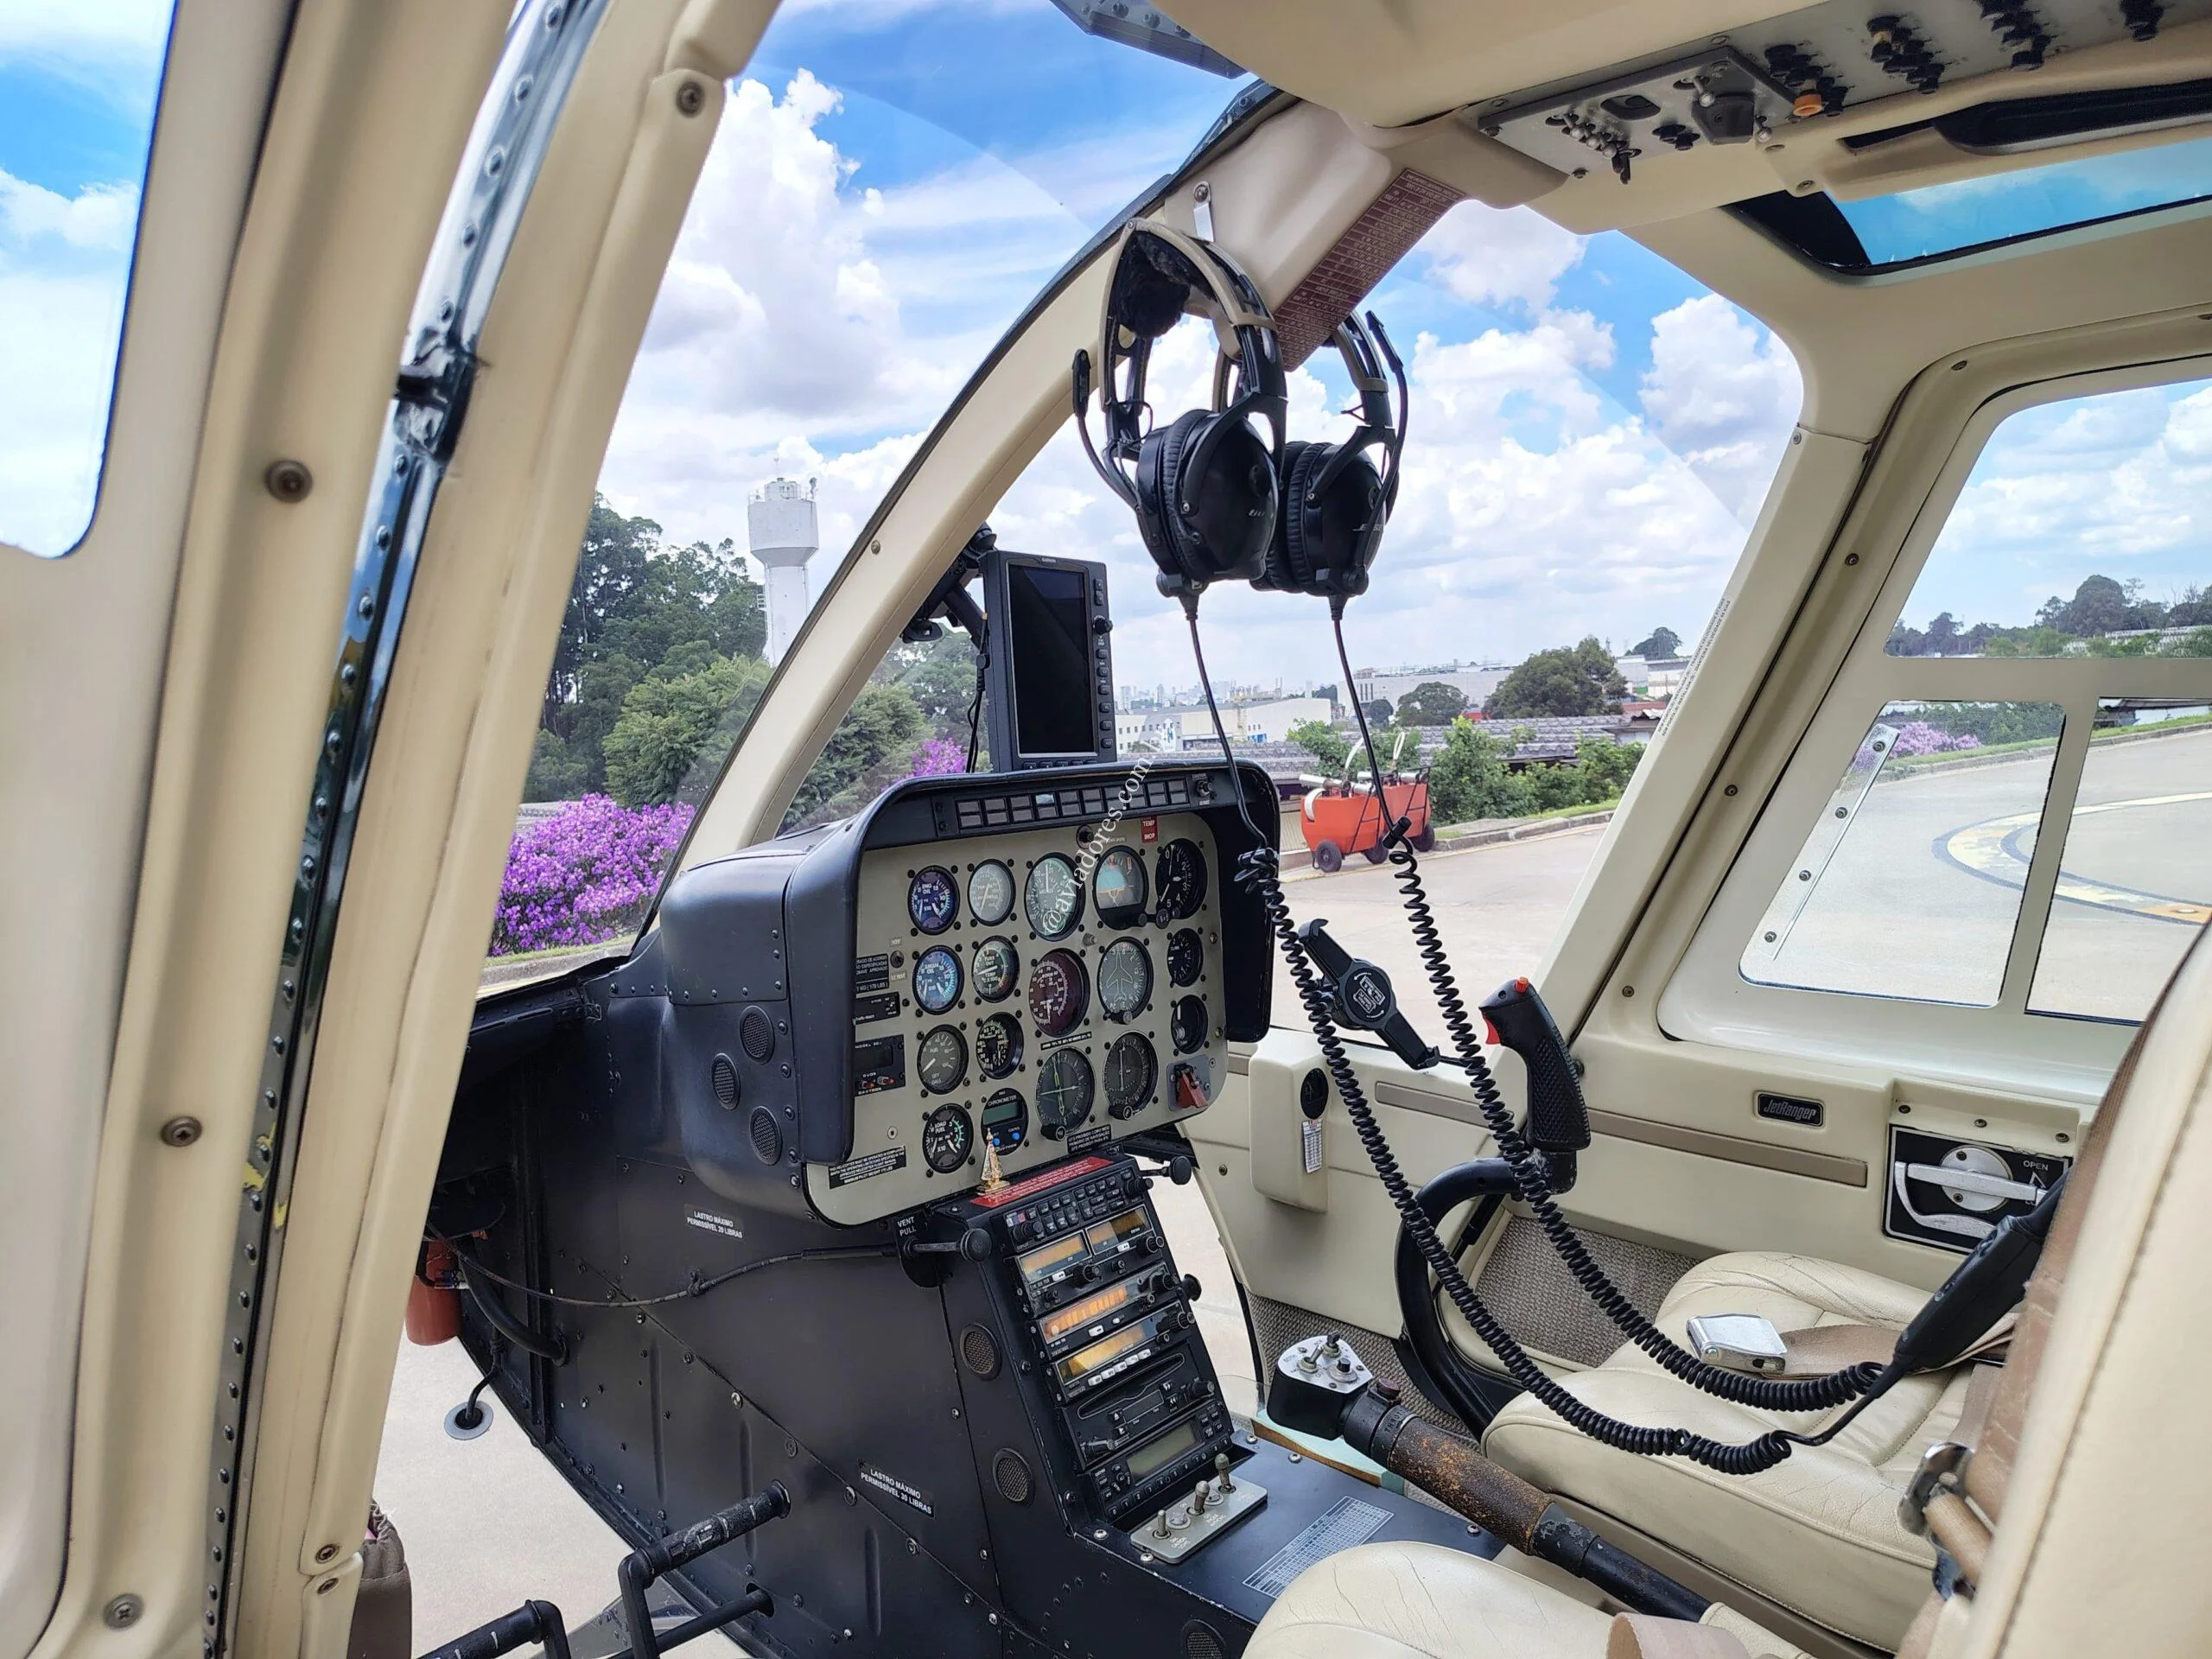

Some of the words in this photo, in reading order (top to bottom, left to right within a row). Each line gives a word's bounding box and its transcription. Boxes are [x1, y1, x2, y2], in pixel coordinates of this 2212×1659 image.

[988, 1095, 1017, 1107] CHRONOMETER
[1764, 1099, 1816, 1120] JetRanger
[2023, 1160, 2048, 1171] OPEN
[694, 1211, 713, 1222] LASTRO
[898, 1217, 914, 1227] VENT
[724, 1227, 743, 1239] LIBRAS
[899, 1226, 917, 1236] PULL
[870, 1469, 895, 1486] LASTRO
[900, 1492, 908, 1502] 30
[909, 1497, 932, 1515] LIBRAS
